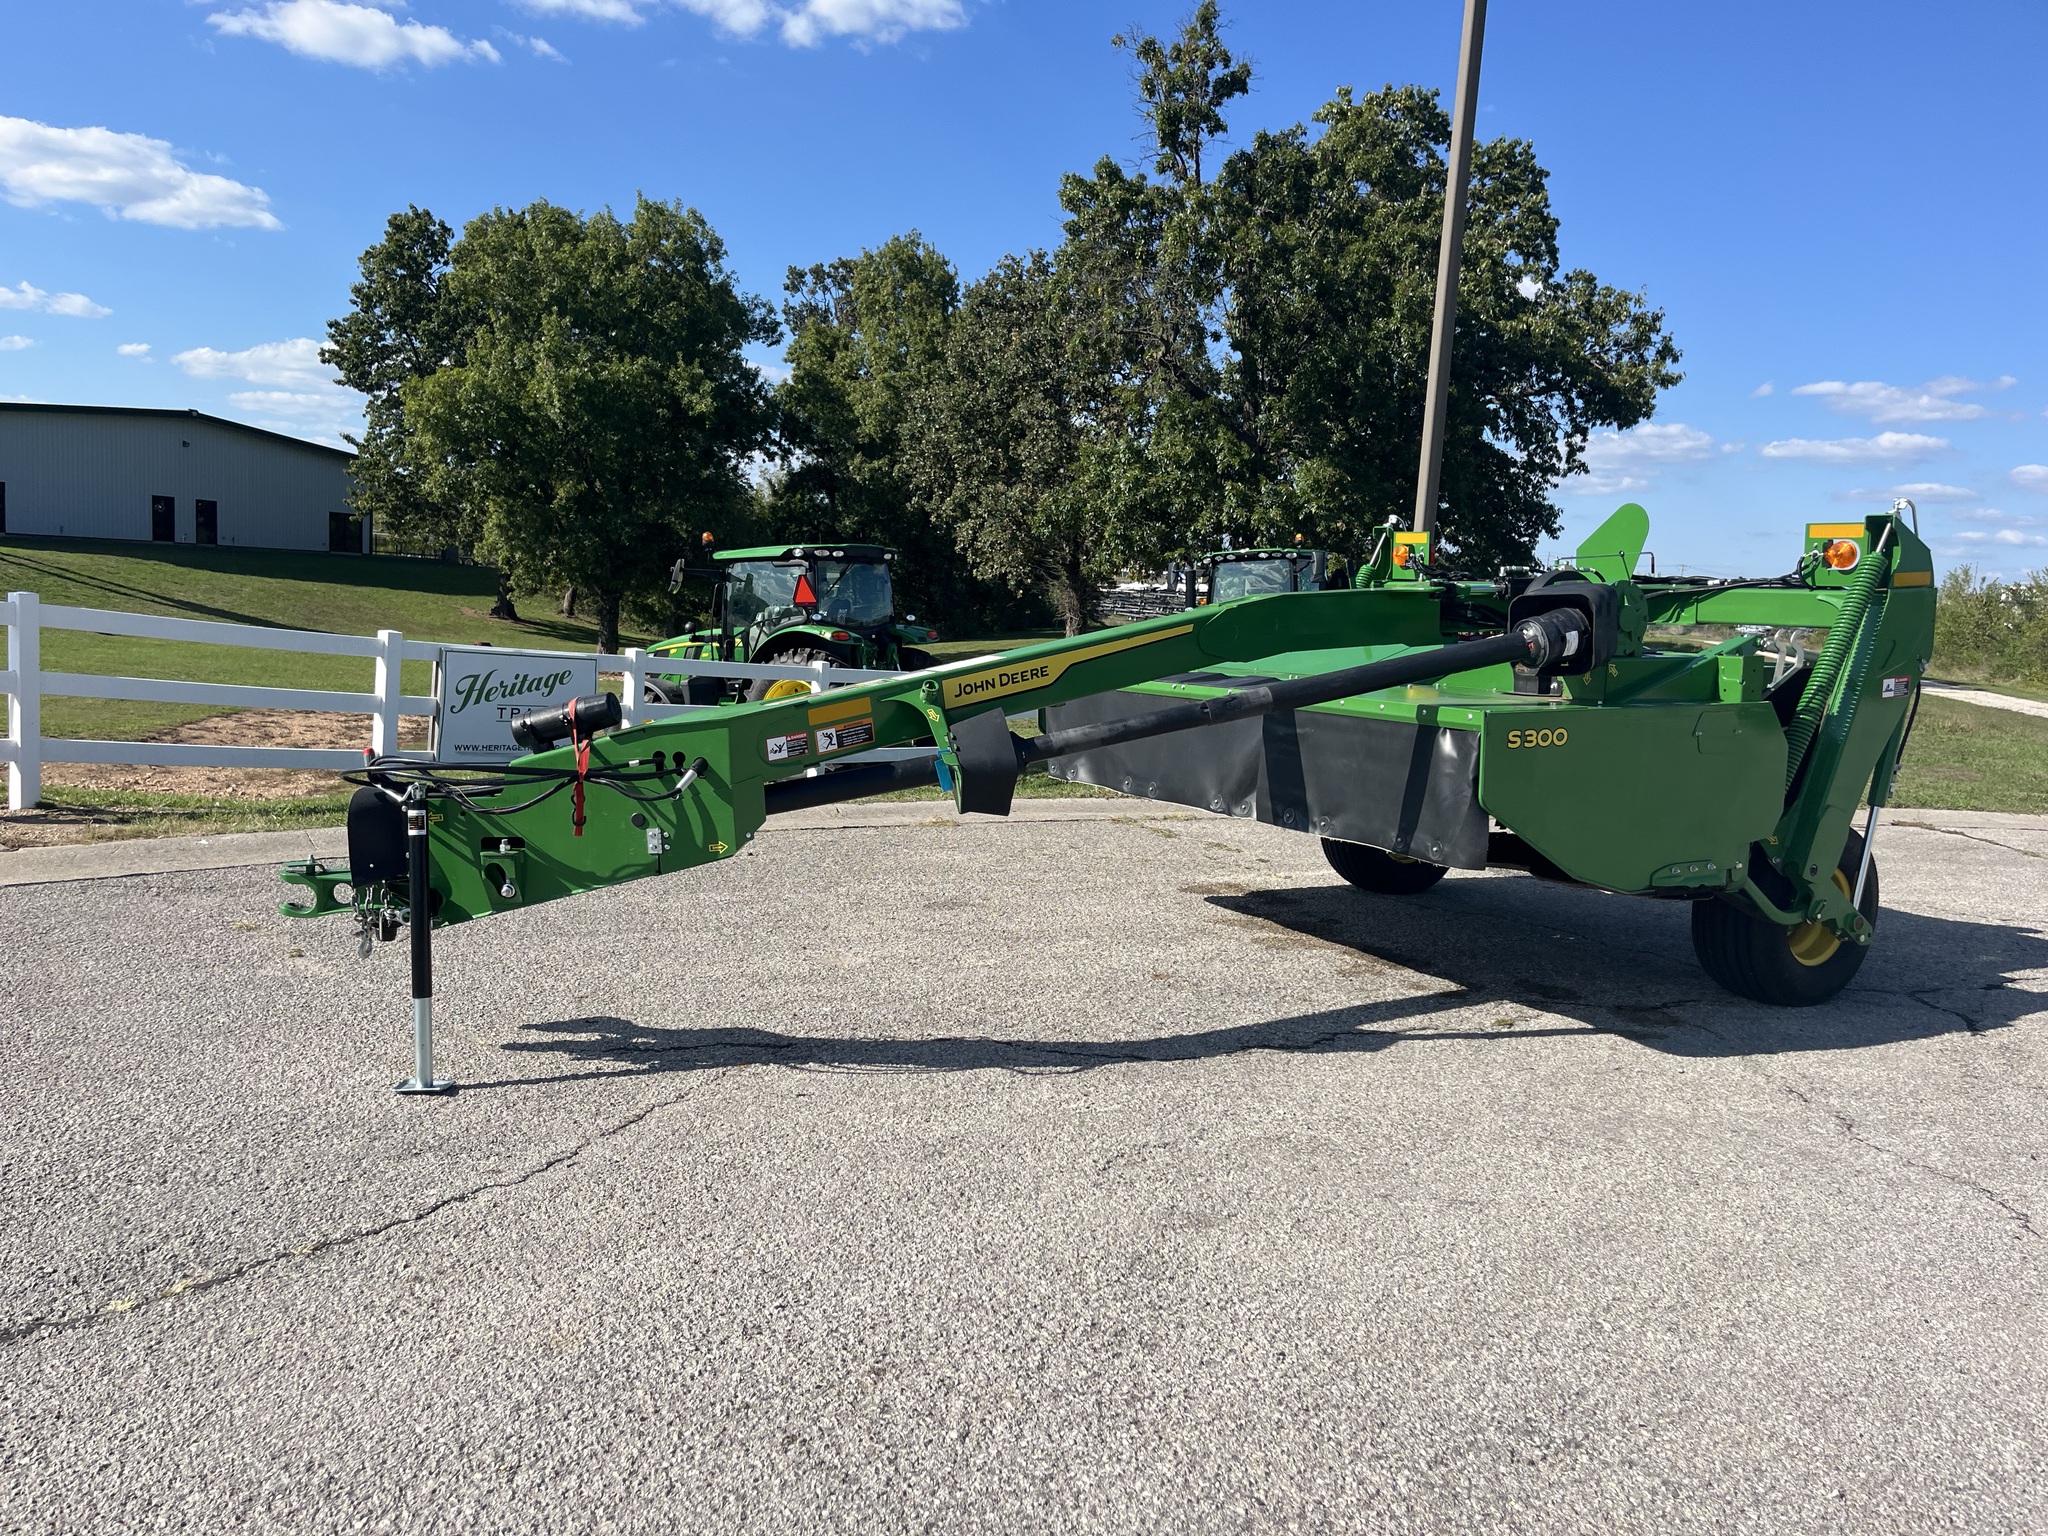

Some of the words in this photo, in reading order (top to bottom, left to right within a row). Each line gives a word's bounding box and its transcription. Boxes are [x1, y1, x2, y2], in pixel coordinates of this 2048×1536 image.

[450, 669, 574, 714] Heritage
[954, 678, 996, 698] JOHN
[999, 665, 1049, 687] DEERE
[1507, 727, 1568, 749] S300
